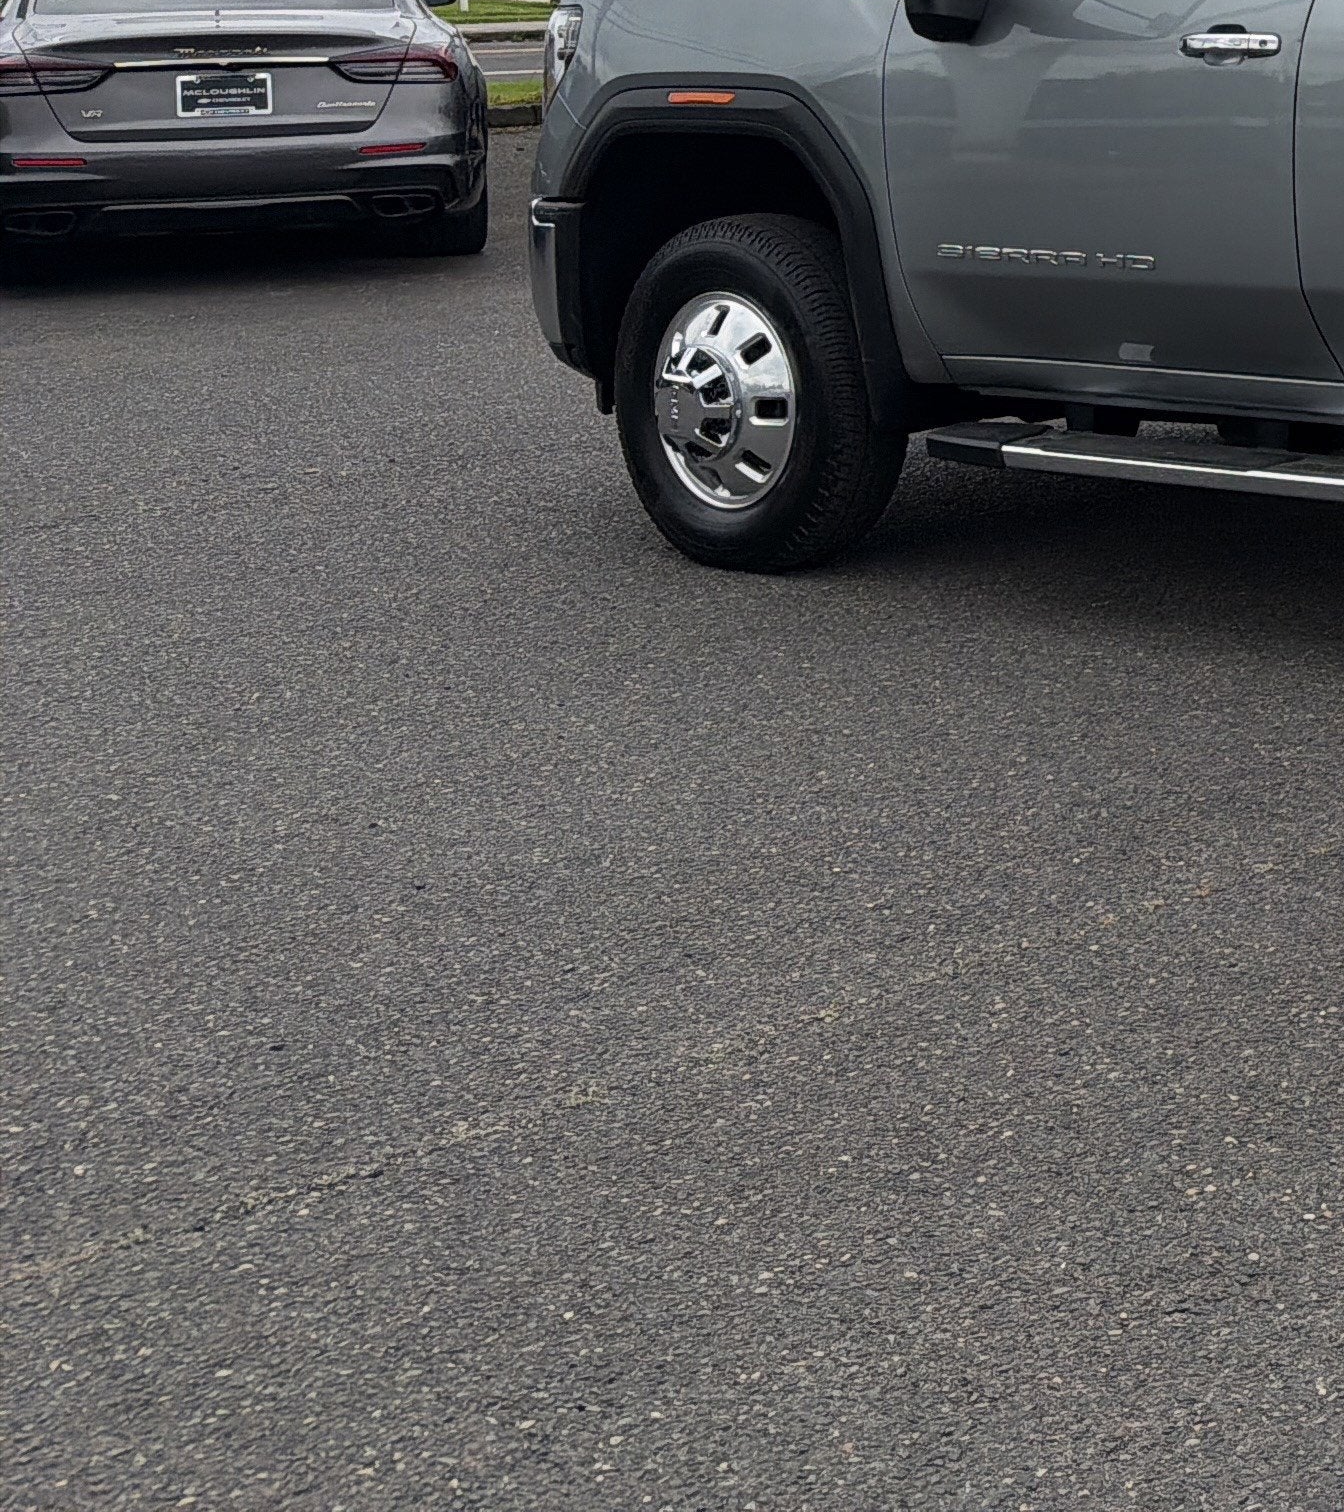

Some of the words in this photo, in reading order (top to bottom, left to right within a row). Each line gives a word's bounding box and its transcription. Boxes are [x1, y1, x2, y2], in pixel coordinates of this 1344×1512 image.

[182, 87, 266, 97] MCLOUGHLIN
[937, 243, 1087, 266] SIERRA
[1096, 252, 1155, 271] HD
